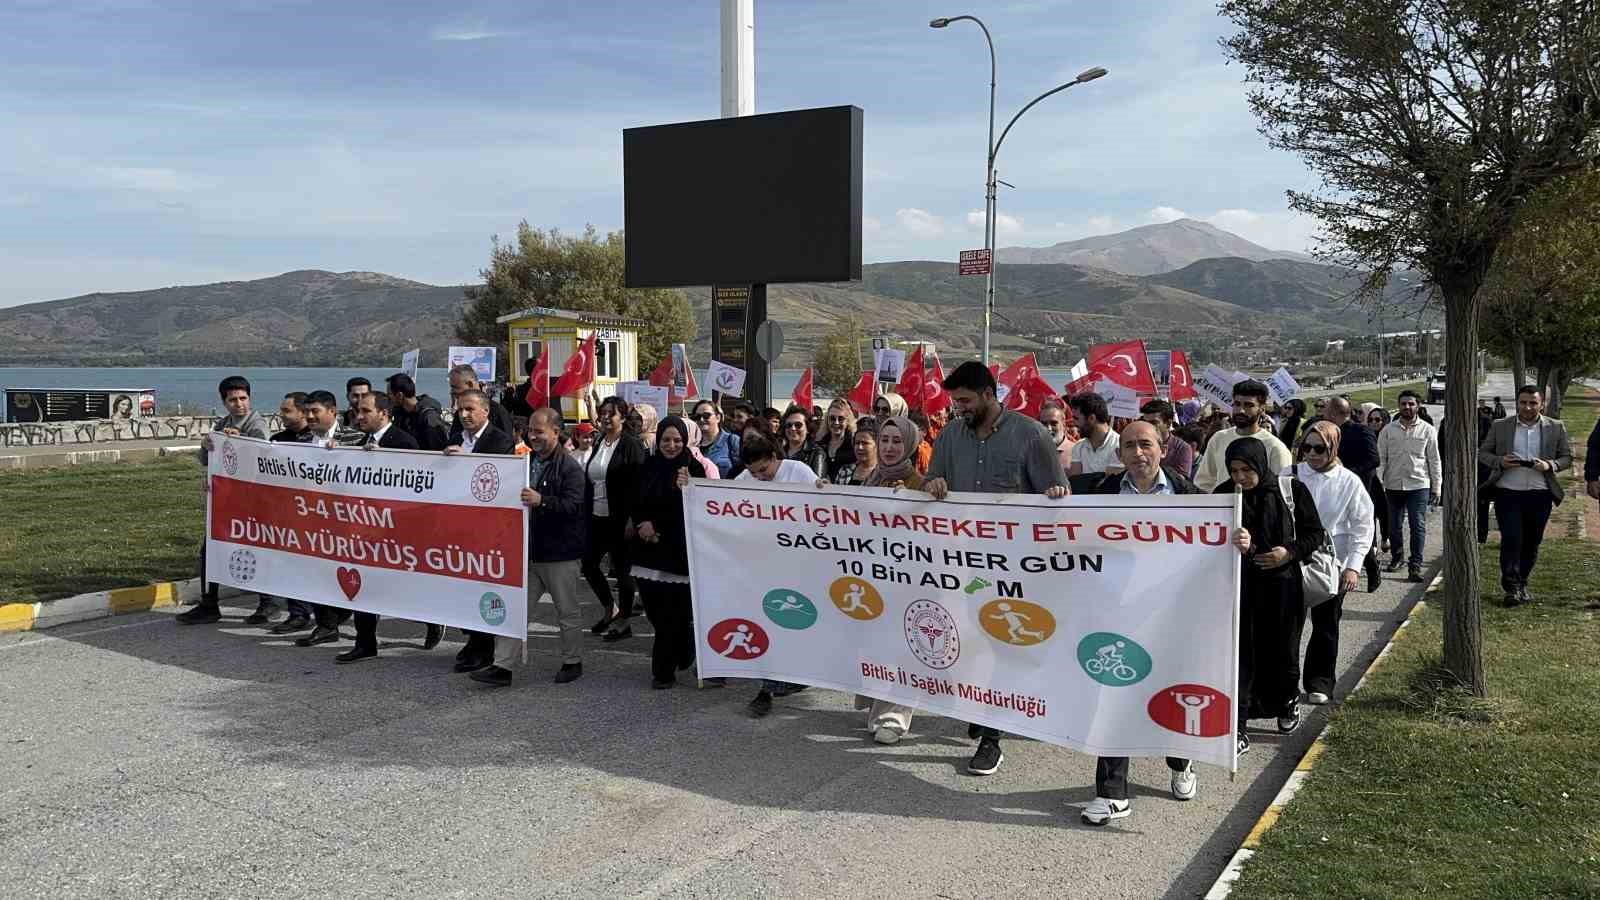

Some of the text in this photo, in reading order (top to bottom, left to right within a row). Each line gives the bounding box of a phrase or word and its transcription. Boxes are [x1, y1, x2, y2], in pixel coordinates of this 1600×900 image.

[257, 457, 435, 493] Bitlis İl Sağlık Müdürlüğü
[296, 495, 395, 529] 3-4 EKİM
[706, 499, 1228, 546] SAĞLIK İÇİN HAREKET ET GÜNÜ
[230, 517, 505, 580] DÜNYA YÜRÜYÜŞ GÜNÜ
[776, 532, 1103, 573] SAĞLIK İÇİN HER GÜN
[837, 559, 864, 576] 10
[872, 563, 912, 585] Bin
[861, 662, 1046, 718] Bitlis İl Sağlık Müdürlüğü
